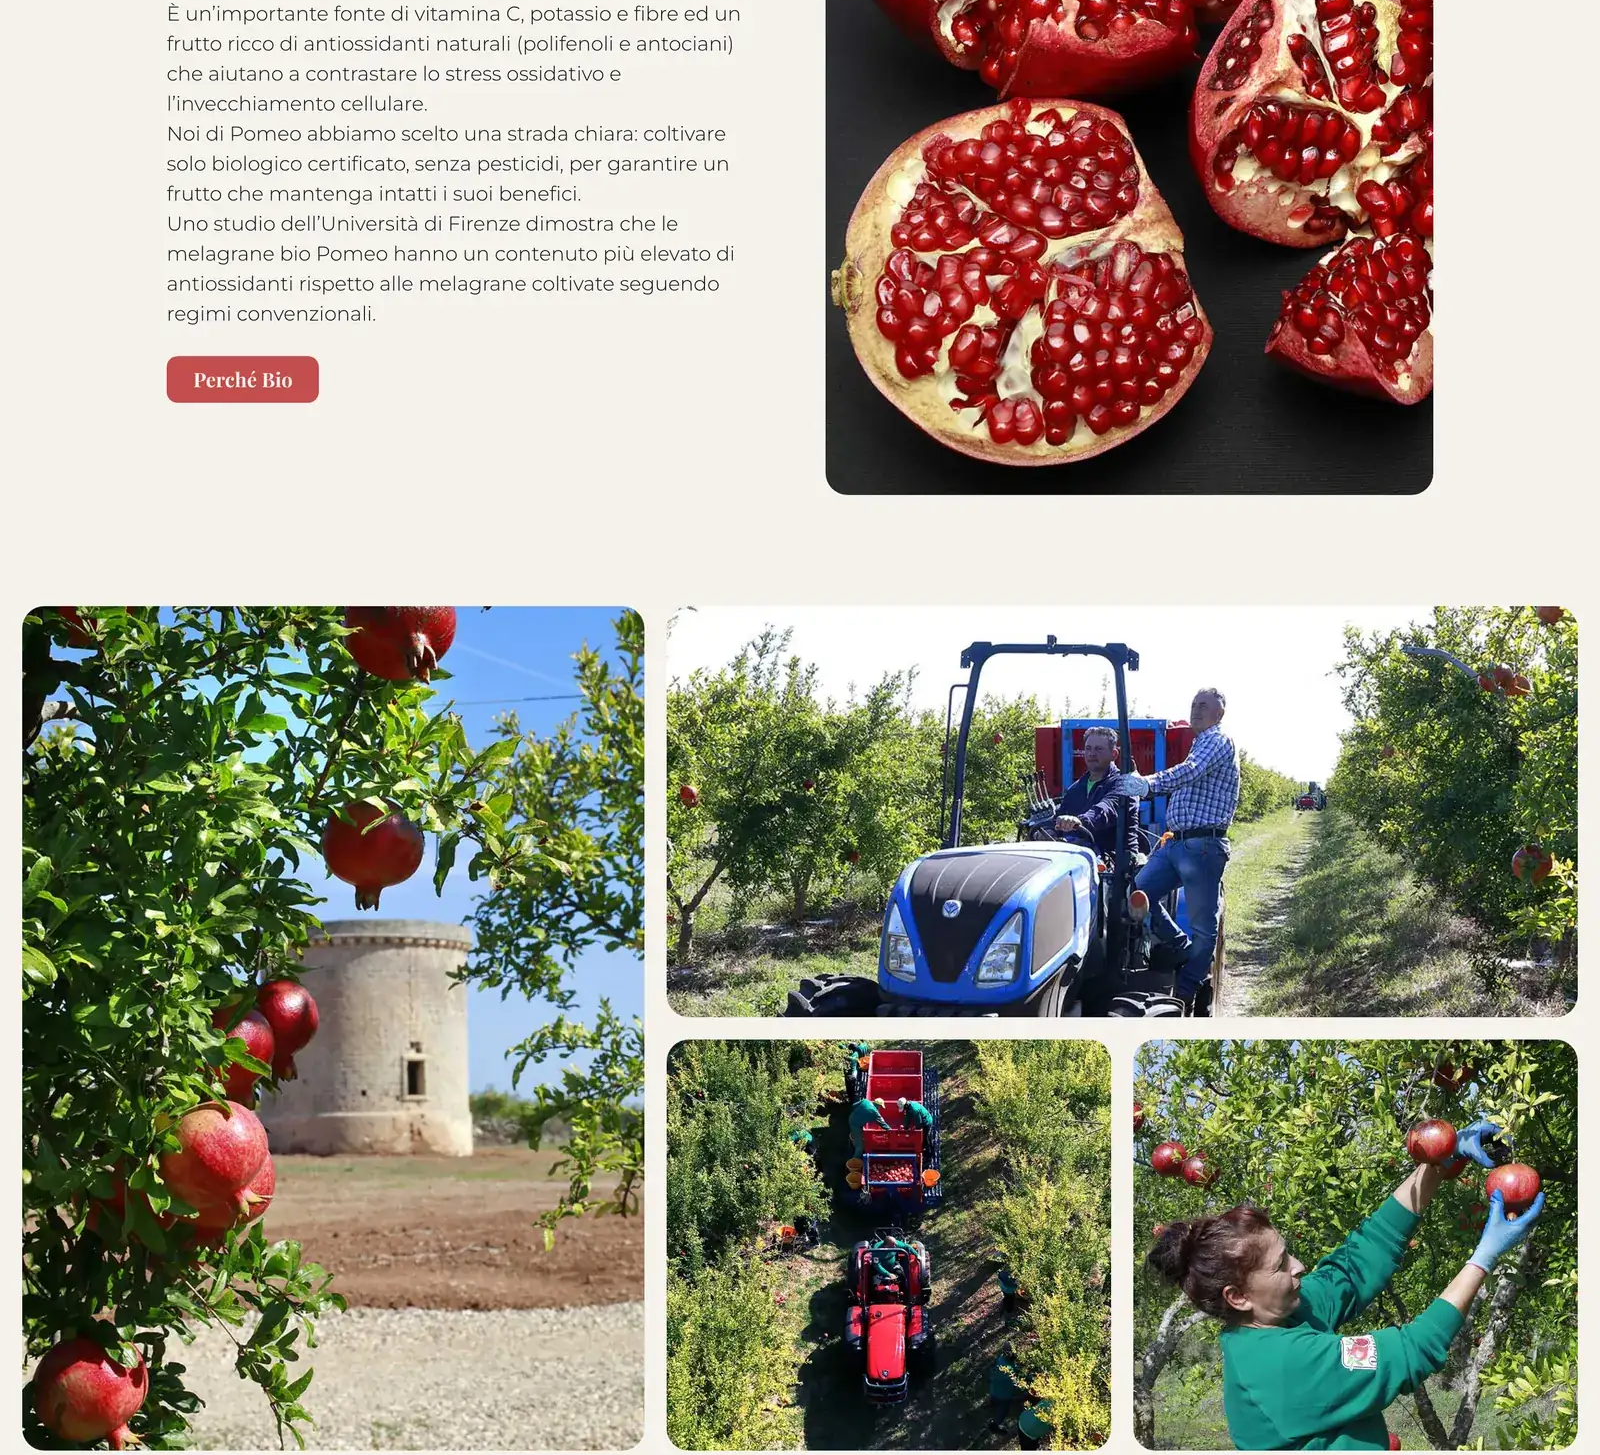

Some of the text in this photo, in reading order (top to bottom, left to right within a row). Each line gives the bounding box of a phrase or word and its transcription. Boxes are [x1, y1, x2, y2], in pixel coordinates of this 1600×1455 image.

[167, 94, 428, 112] l’invecchiamento cellulare.
[167, 304, 376, 326] regimi convenzionali.
[193, 370, 293, 389] Perché Bio
